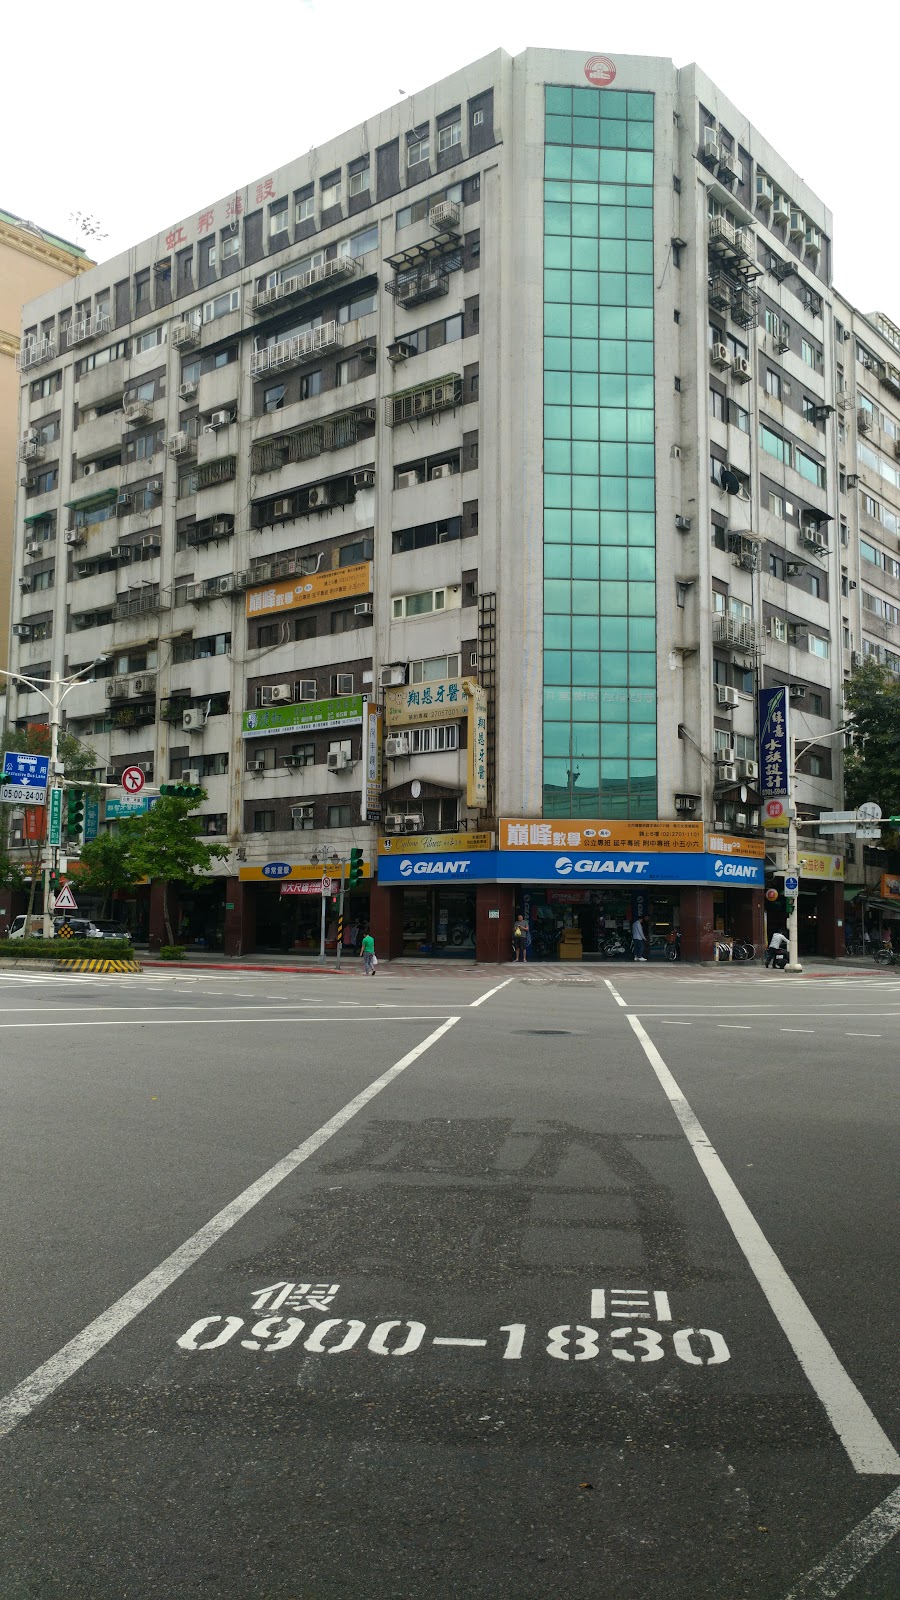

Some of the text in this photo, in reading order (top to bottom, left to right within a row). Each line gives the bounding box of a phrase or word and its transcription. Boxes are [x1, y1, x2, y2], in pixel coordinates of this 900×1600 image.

[407, 683, 460, 707] 翔恩牙醫
[672, 840, 700, 848] 小五小六
[414, 861, 470, 873] GIANT
[574, 860, 649, 873] GIANT
[724, 864, 758, 877] GIANT
[251, 1282, 671, 1321] 假 日
